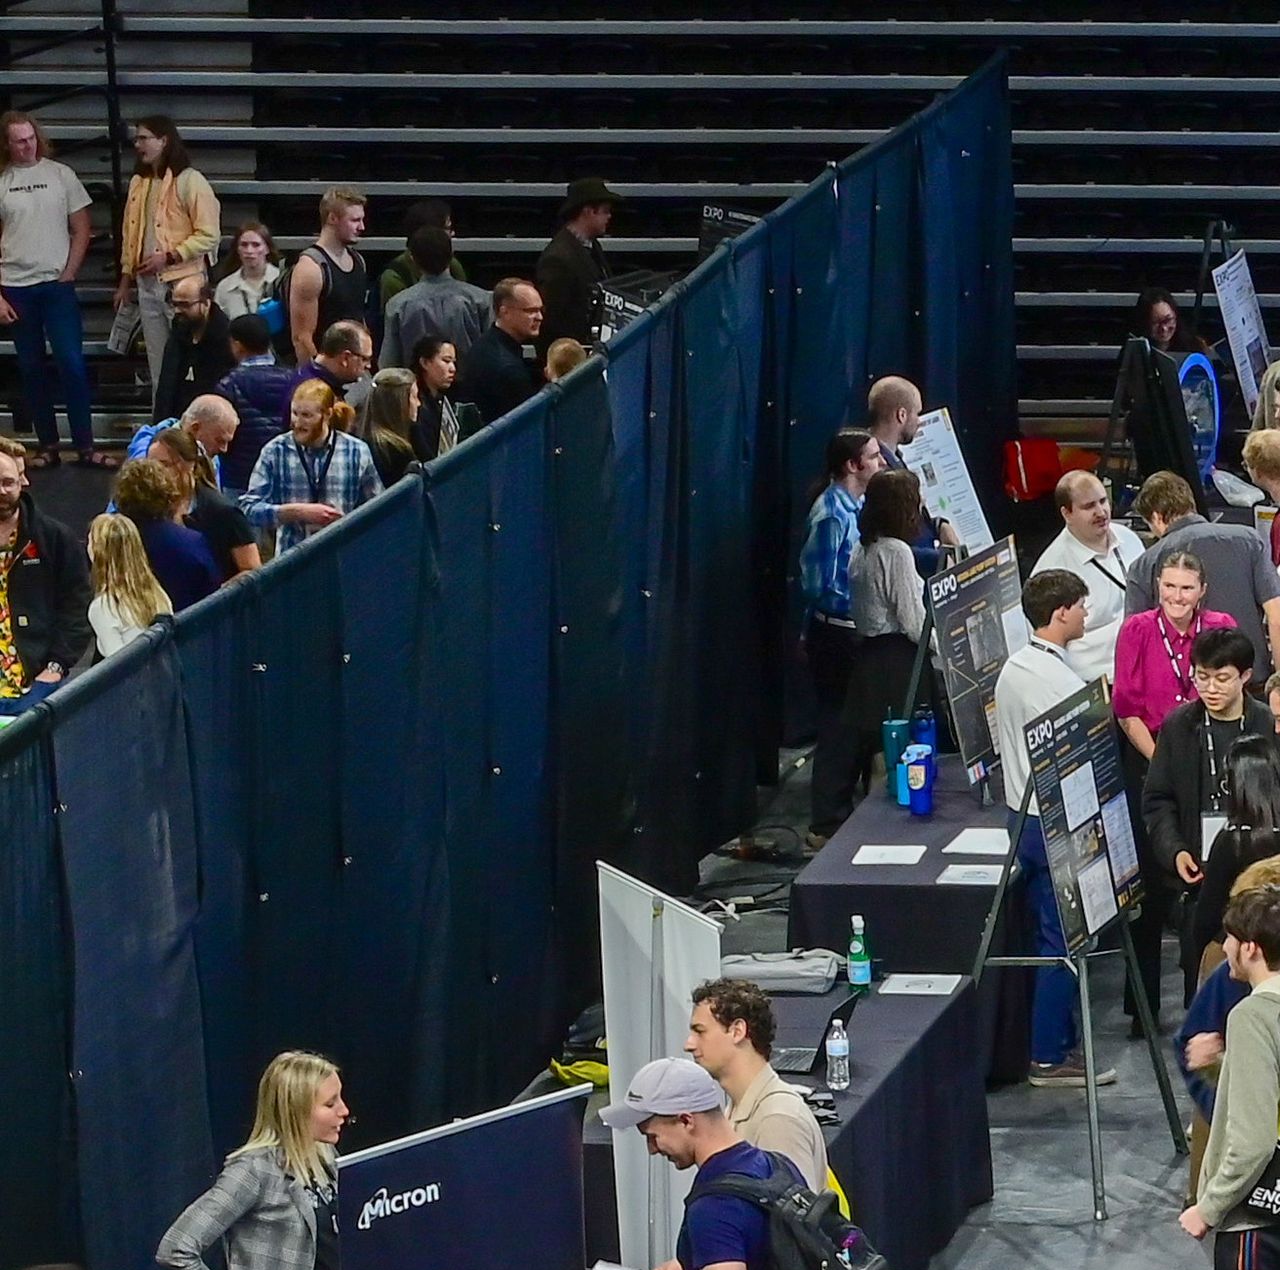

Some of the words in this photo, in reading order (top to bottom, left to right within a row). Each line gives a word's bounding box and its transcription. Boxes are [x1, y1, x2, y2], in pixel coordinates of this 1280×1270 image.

[703, 205, 724, 221] EXPO
[604, 290, 624, 311] EXPO
[931, 574, 957, 601] EXPO
[1026, 719, 1053, 751] EXPO
[358, 1181, 441, 1230] Micron
